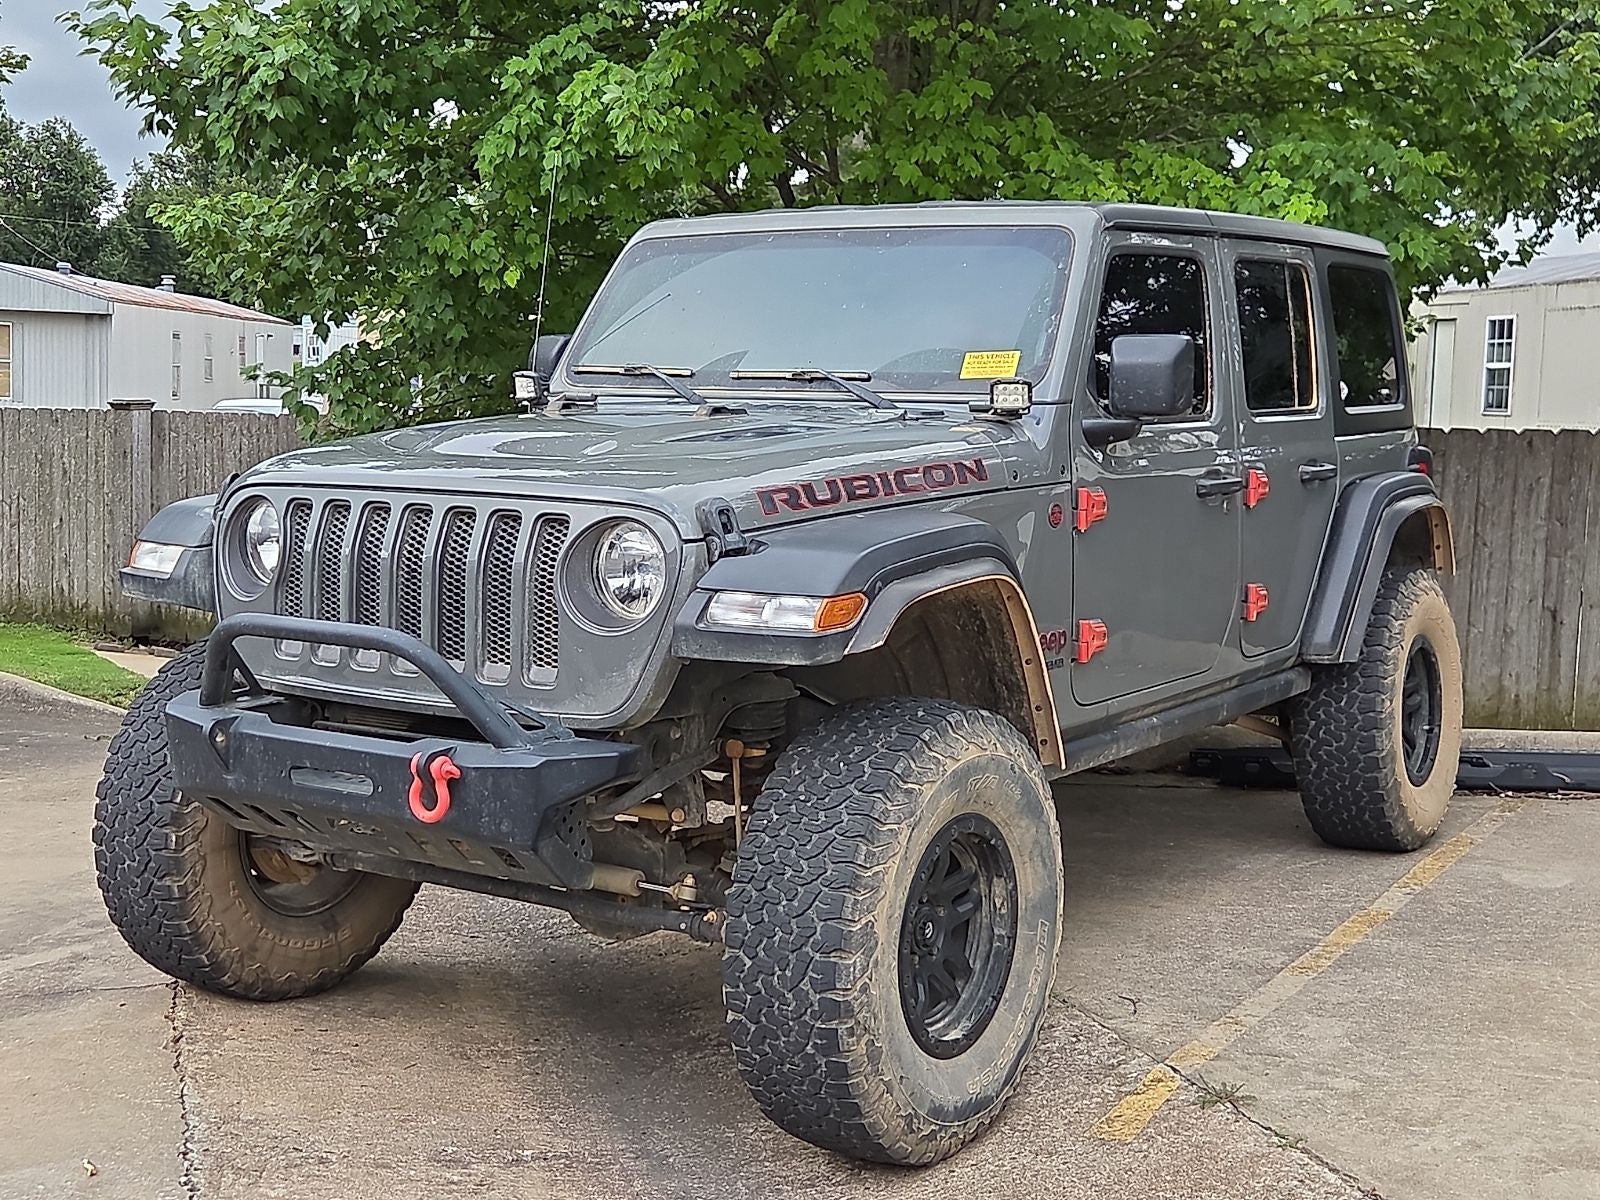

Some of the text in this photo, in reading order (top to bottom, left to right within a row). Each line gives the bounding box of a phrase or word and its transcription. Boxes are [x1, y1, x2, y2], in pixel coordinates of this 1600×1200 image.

[986, 352, 1016, 360] VEHICLE
[755, 457, 989, 516] RUBICON
[1038, 629, 1067, 655] eep
